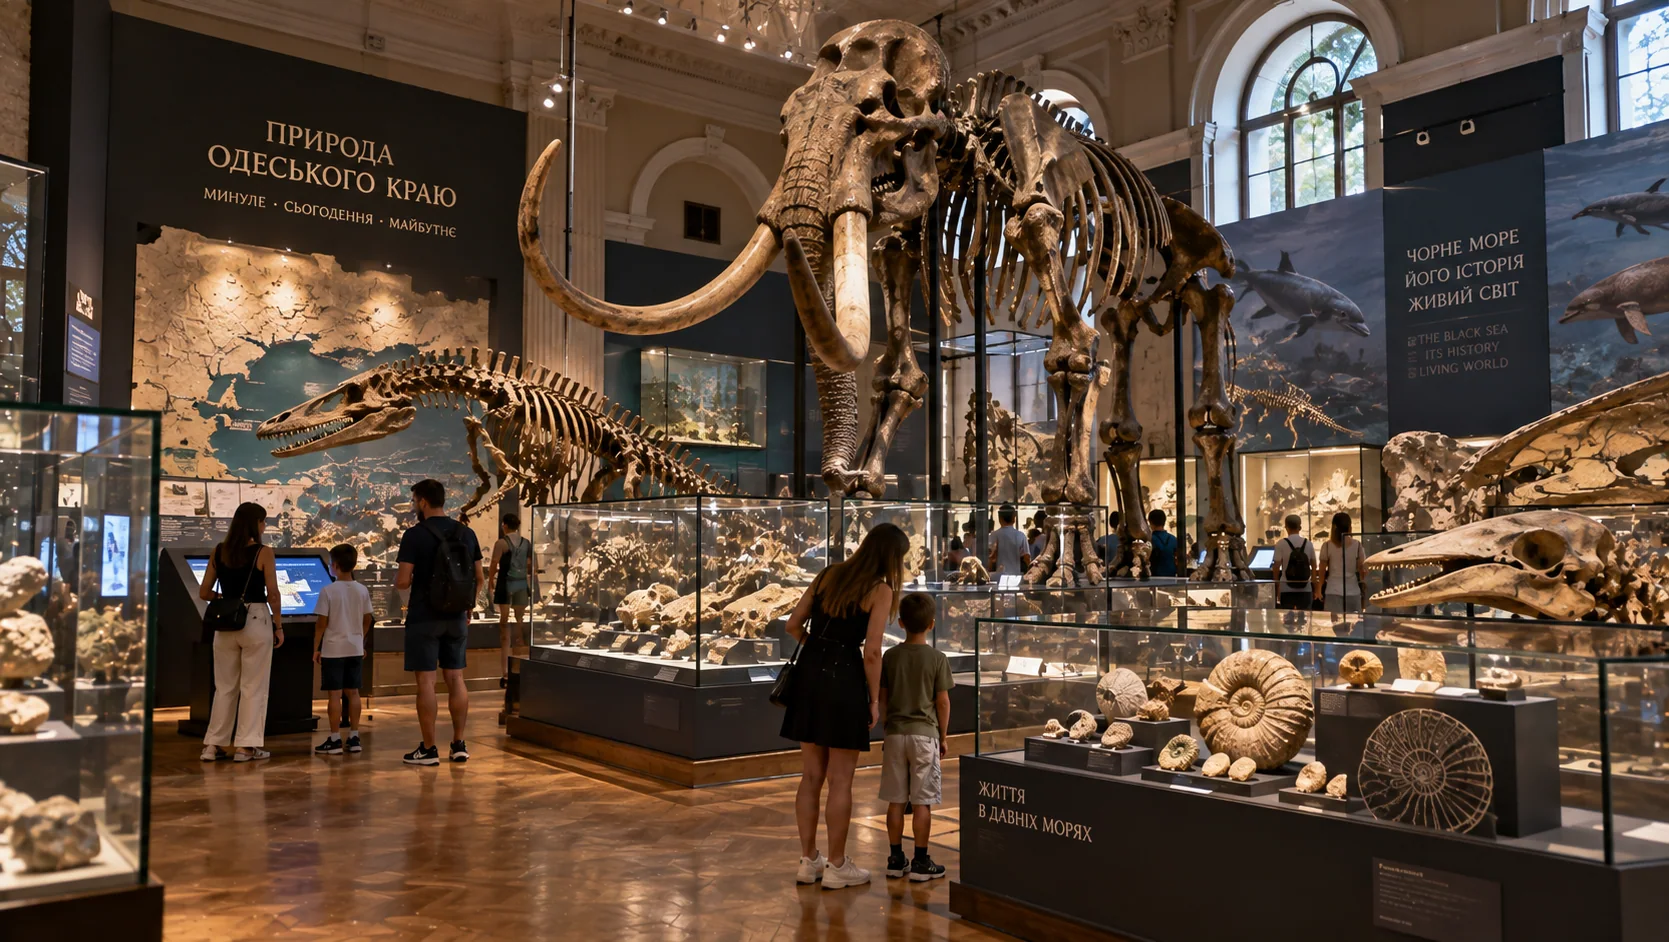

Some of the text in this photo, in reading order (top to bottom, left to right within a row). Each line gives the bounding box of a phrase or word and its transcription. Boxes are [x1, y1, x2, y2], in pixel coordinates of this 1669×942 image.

[266, 120, 395, 166] ПРИРОДА
[207, 144, 457, 208] ОДЕСЬКОГО КРАЮ
[203, 187, 457, 238] МИНУЛЕ СЬОГОДЕННЯ МАЙБУТНЄ
[1407, 228, 1520, 263] ЧОРНЕ МОРЕ
[1405, 253, 1525, 288] ЙОГО ІСТОРІЯ
[1408, 281, 1520, 312] ЖИВИЙ СВІТ
[1417, 332, 1440, 345] THE
[1444, 327, 1481, 341] BLACK
[1486, 324, 1509, 336] SEA
[1425, 348, 1443, 360] ITS
[1447, 341, 1500, 358] HISTORY
[1420, 362, 1459, 377] LIVING
[1463, 357, 1509, 371] WORLD
[978, 780, 1026, 804] ЖИТТЯ
[978, 803, 1093, 843] В ДАВНІХ МОРЯХ
